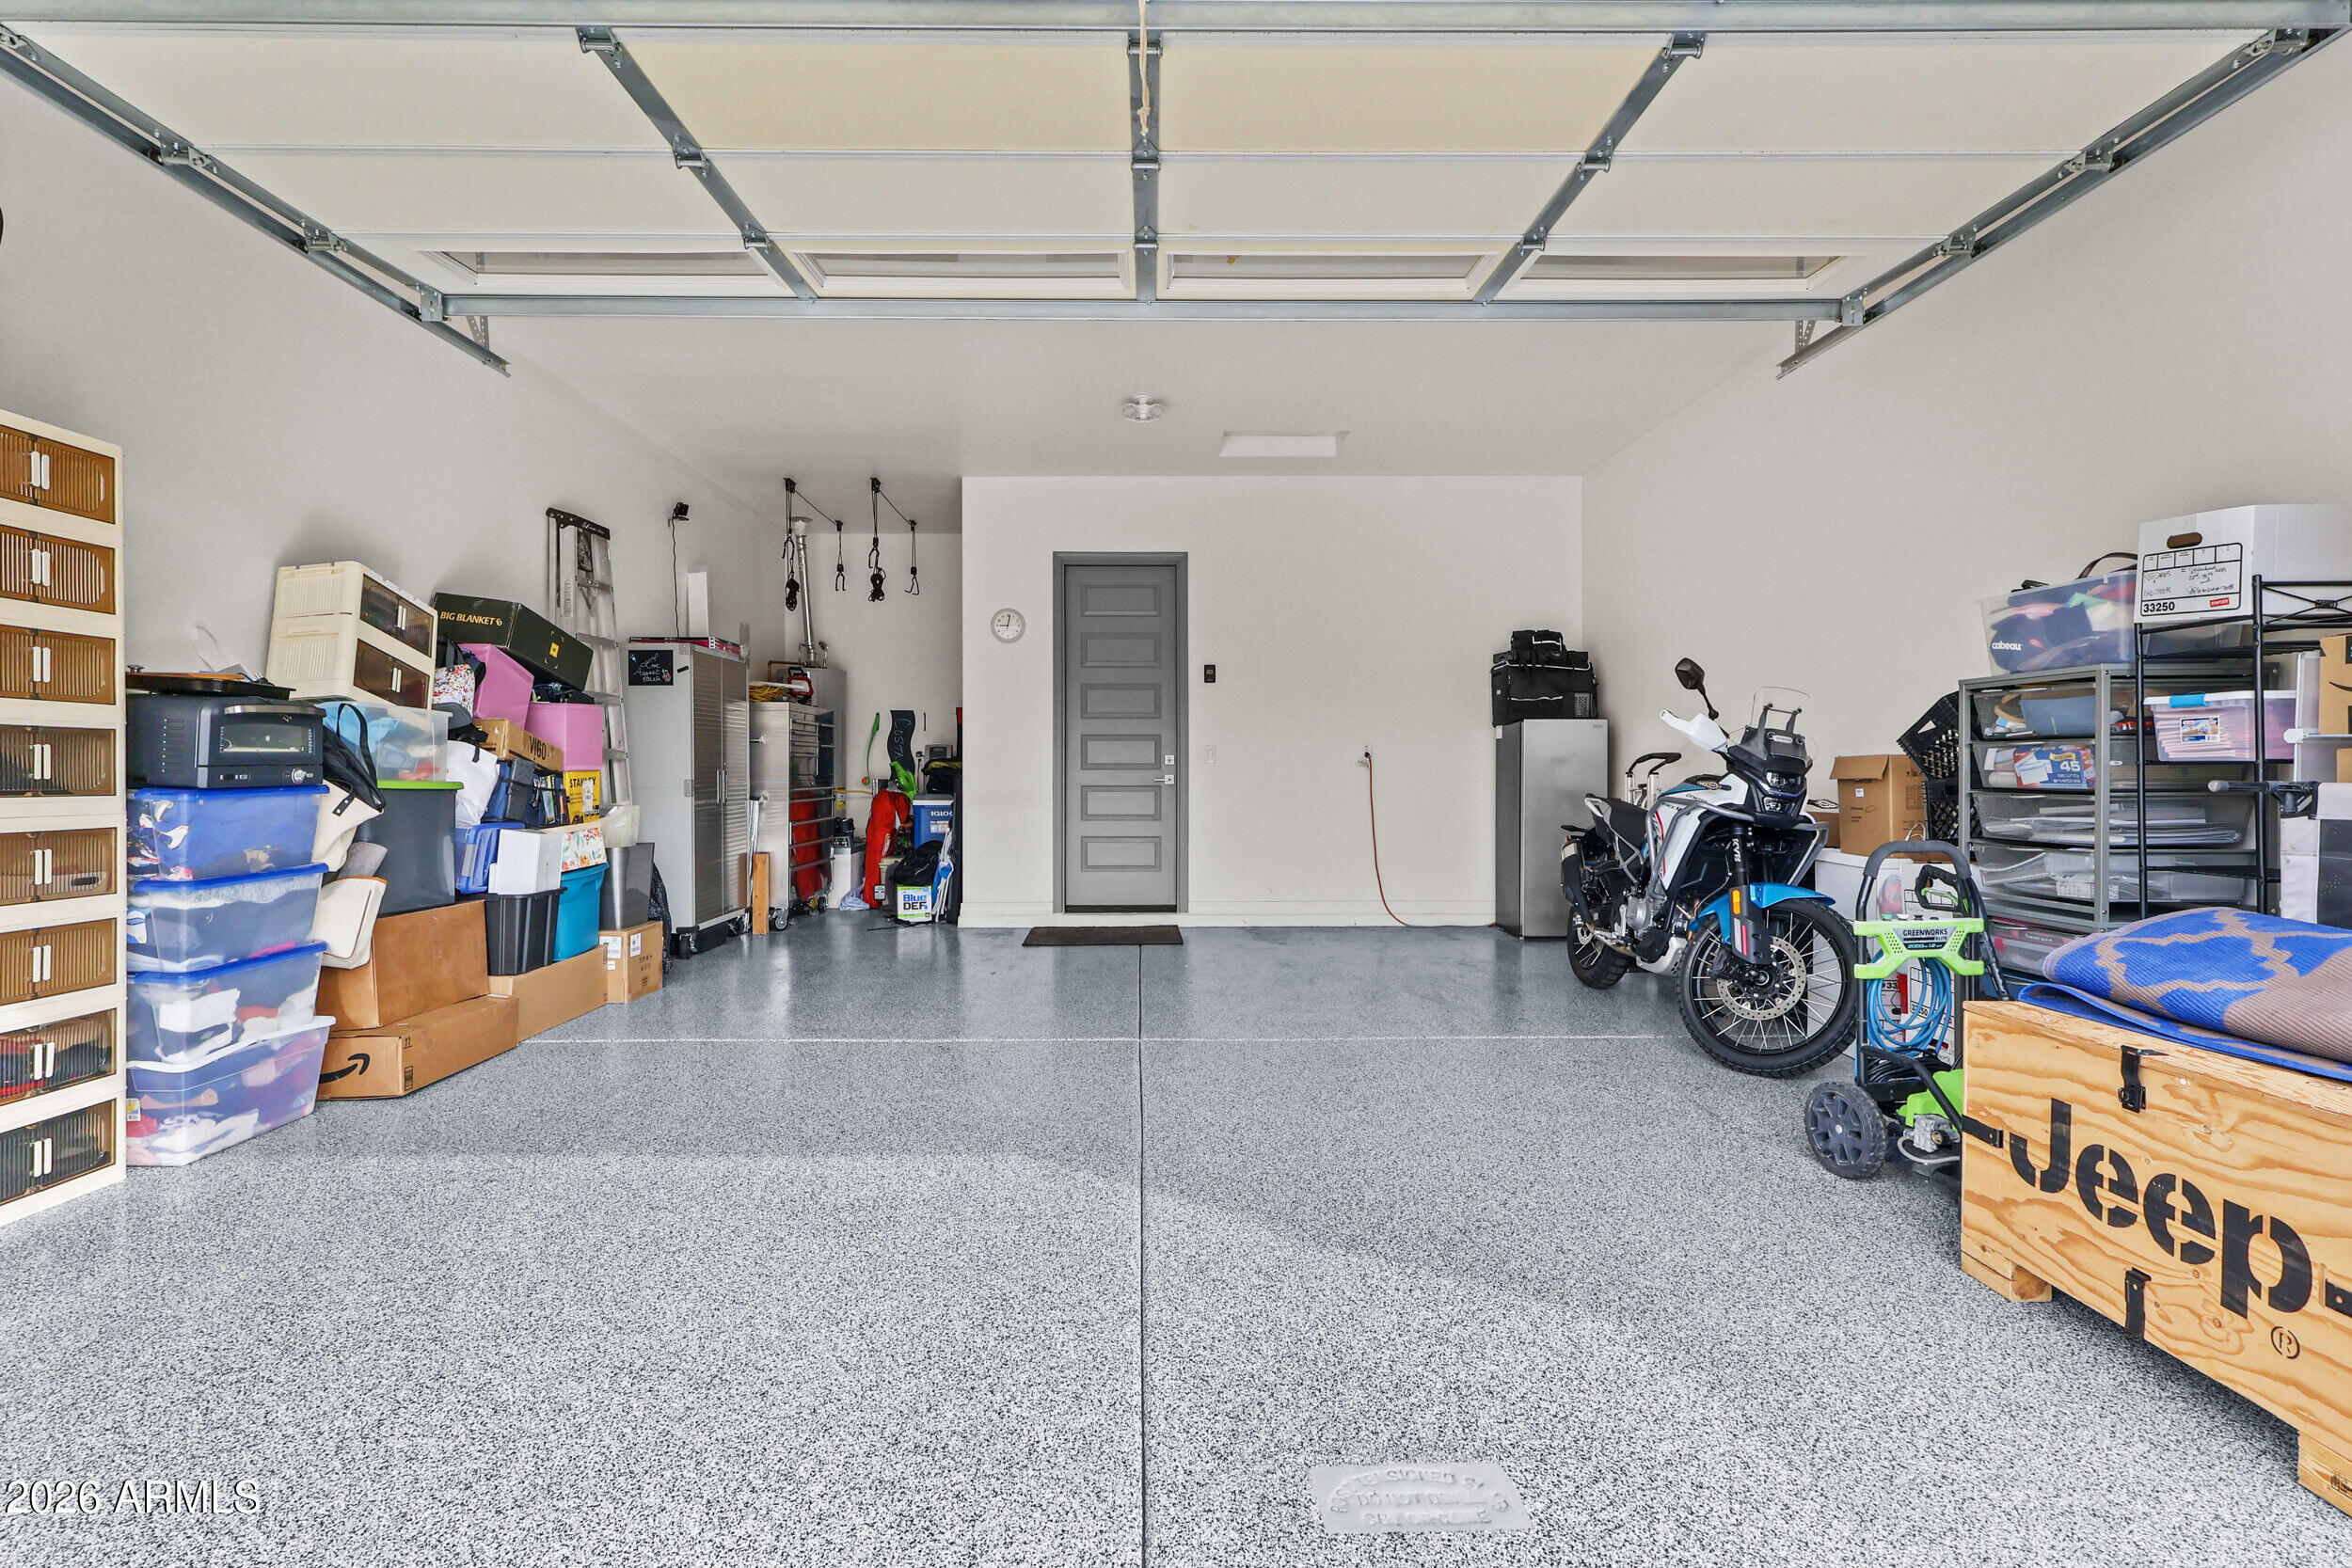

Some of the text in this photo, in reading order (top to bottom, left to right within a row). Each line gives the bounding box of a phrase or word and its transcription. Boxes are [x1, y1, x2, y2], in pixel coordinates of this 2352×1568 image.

[2143, 601, 2175, 612] 33250
[439, 611, 455, 621] BIG
[455, 613, 496, 626] BLANKET
[529, 736, 547, 760] VIGO
[2060, 761, 2081, 772] 45
[903, 901, 927, 910] DEF
[1902, 928, 1948, 937] GREENWORKS
[2010, 1097, 2312, 1320] Jeep
